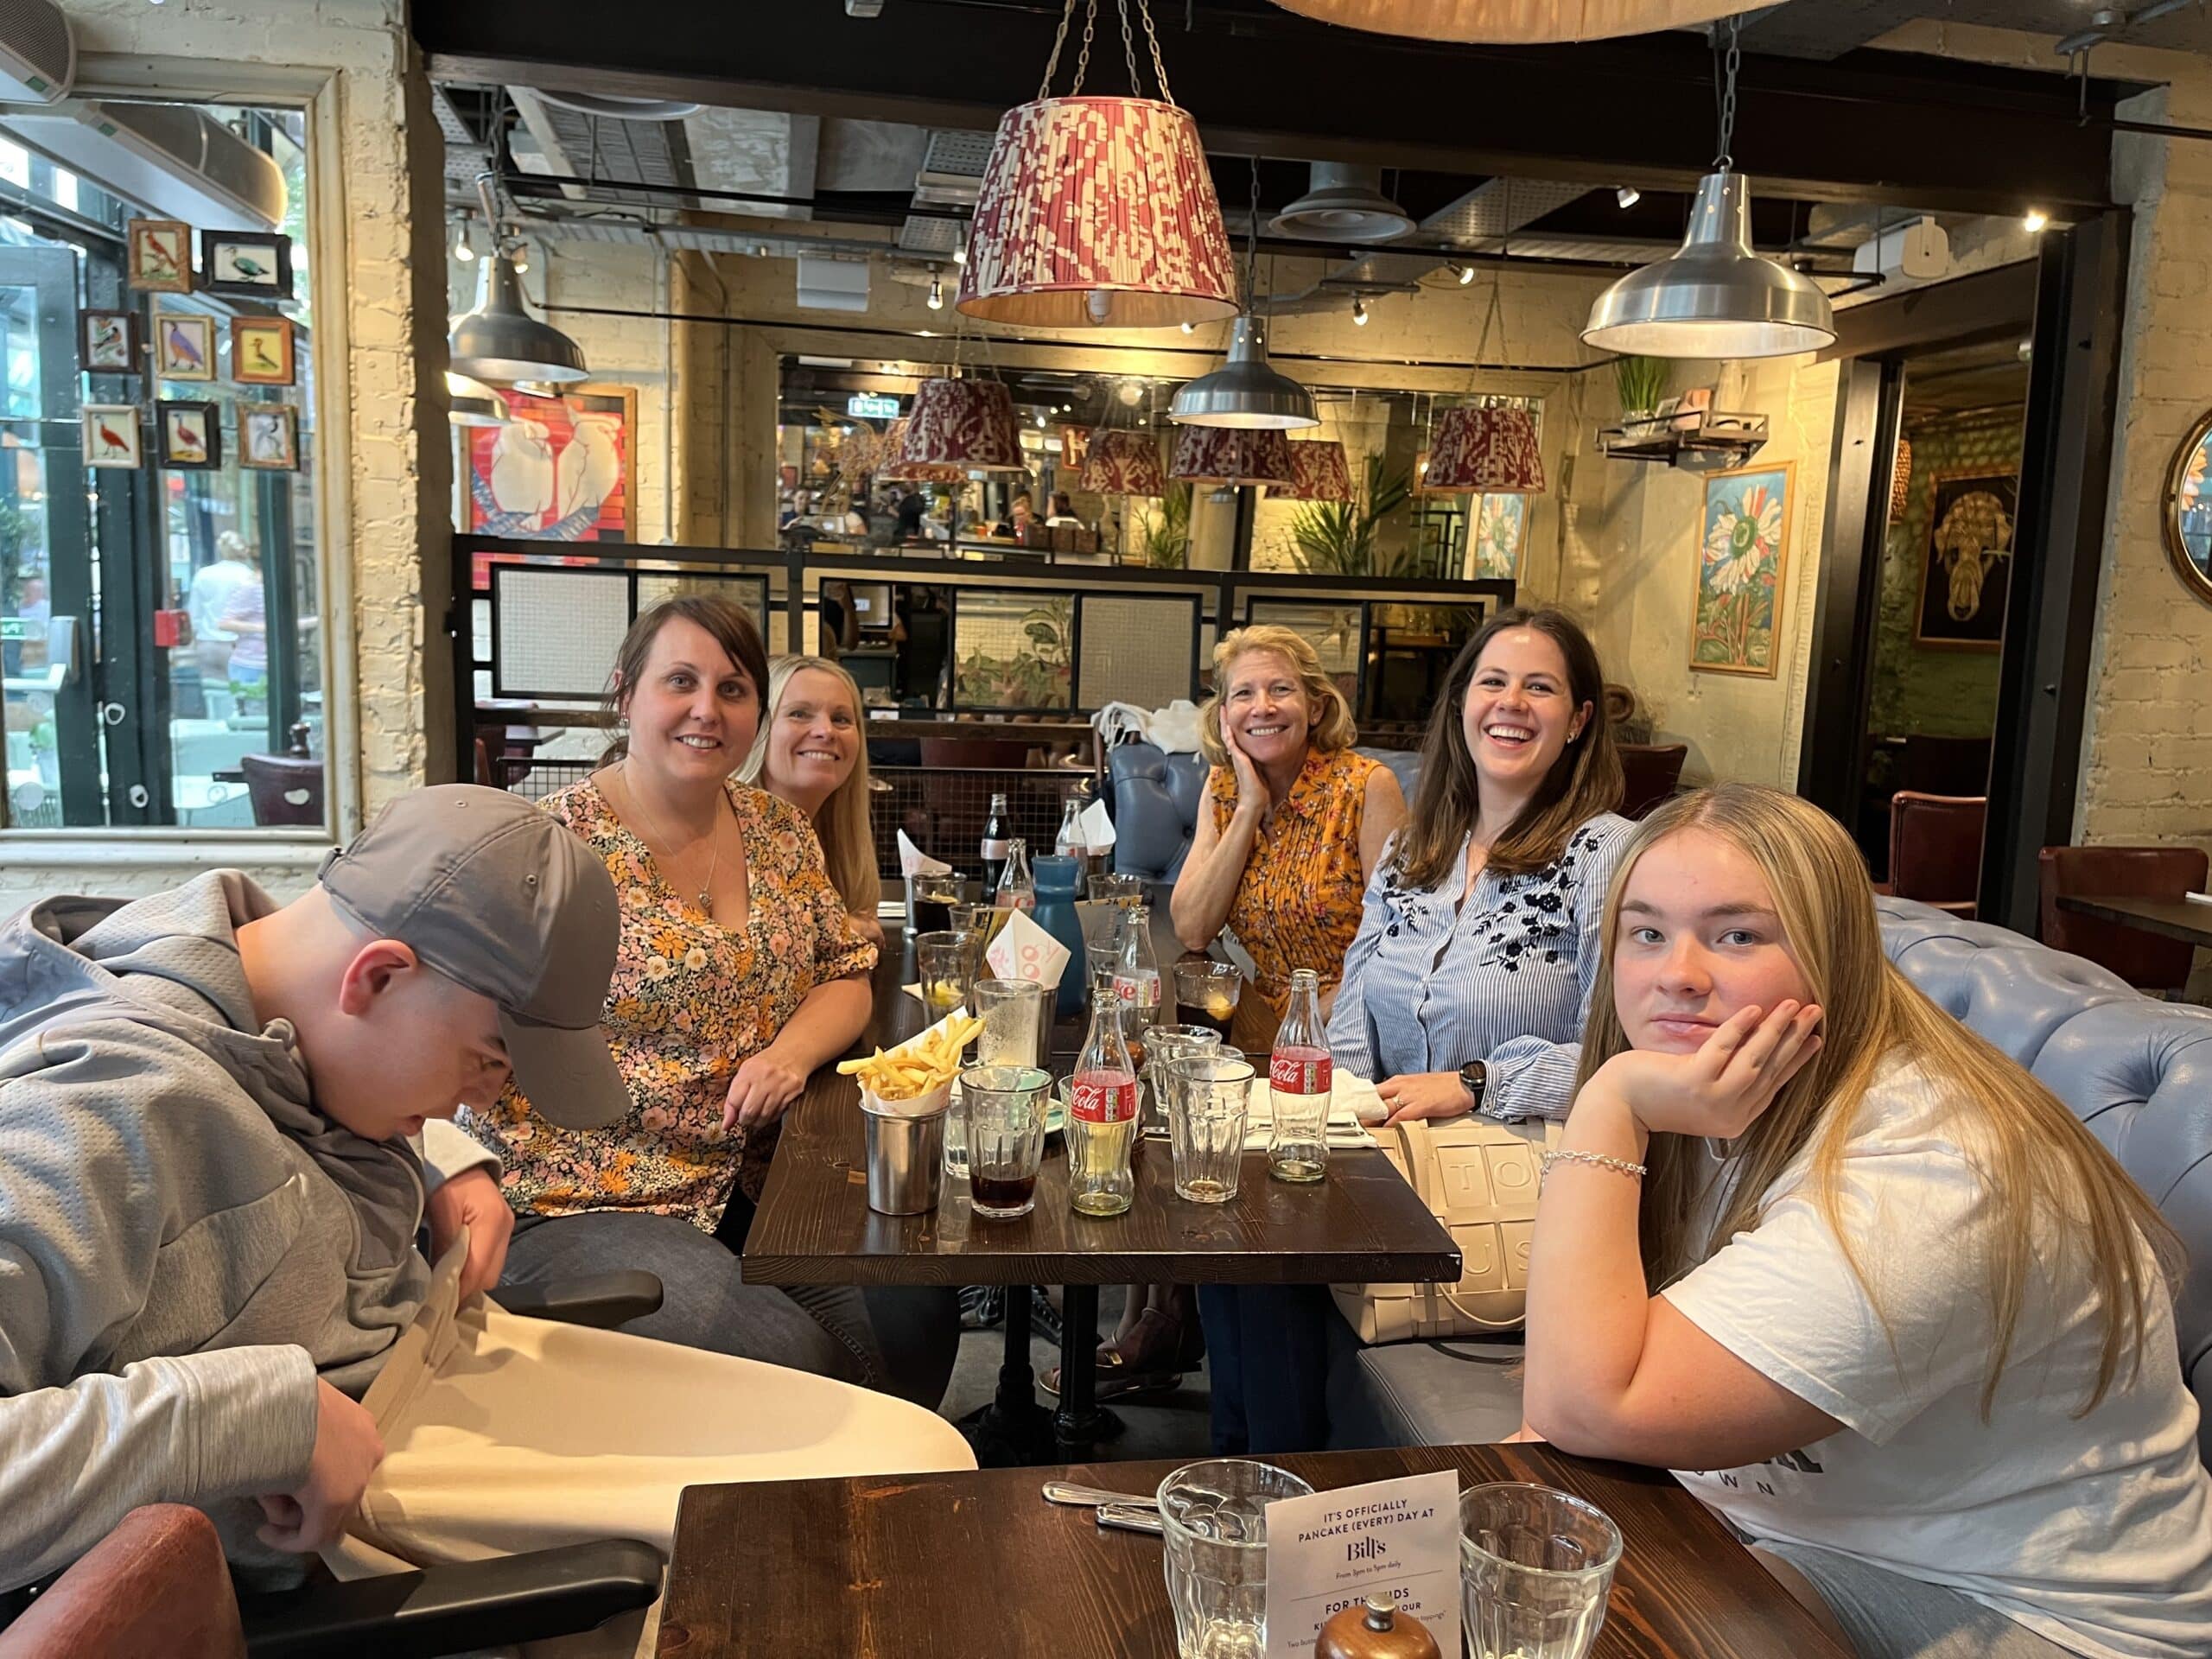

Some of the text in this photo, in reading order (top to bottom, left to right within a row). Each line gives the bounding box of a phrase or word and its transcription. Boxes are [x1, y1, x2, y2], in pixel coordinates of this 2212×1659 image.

[1324, 1499, 1408, 1523] IT'S OFFICIALLY
[1298, 1508, 1434, 1542] PANCAKE (EVERY) DAY AT
[1347, 1536, 1387, 1561] Bill's
[1388, 1560, 1402, 1569] daily
[1325, 1588, 1409, 1615] FOR TH IDS
[1402, 1602, 1421, 1612] OUR
